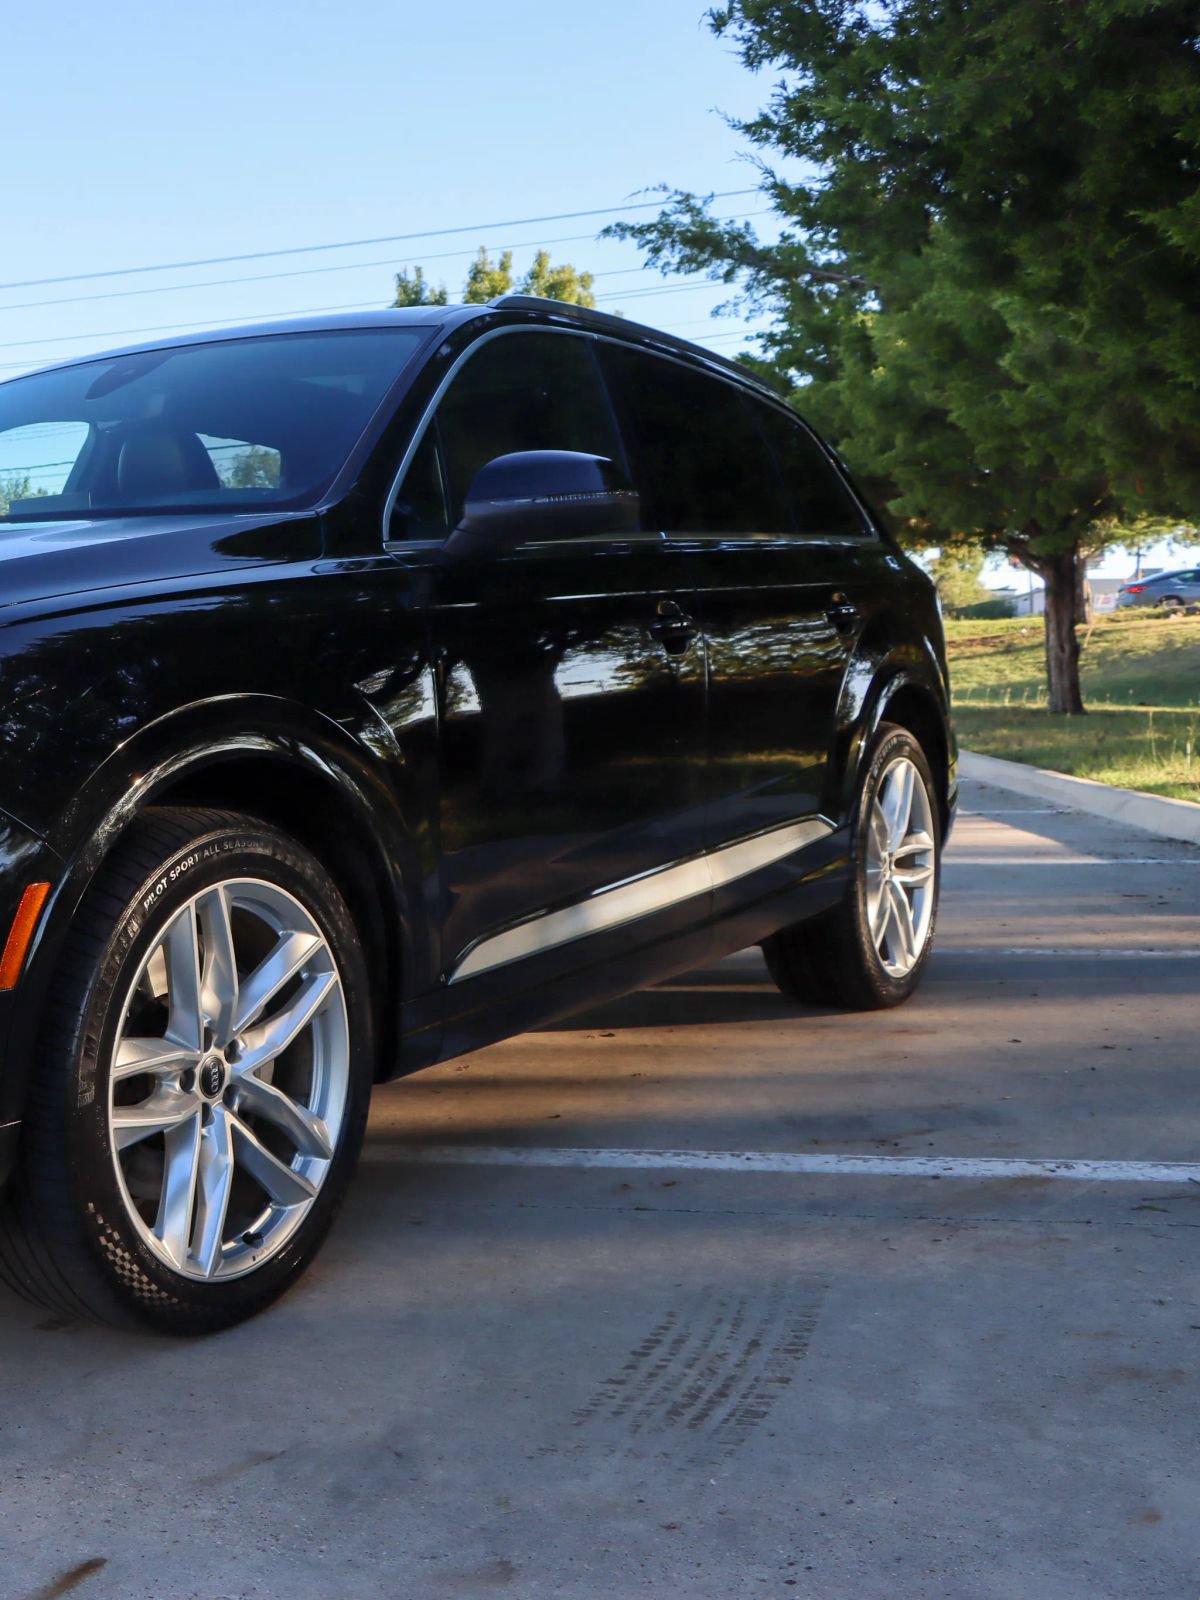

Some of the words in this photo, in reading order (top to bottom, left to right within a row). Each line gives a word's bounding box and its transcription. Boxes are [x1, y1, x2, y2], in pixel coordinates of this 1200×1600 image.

[143, 877, 168, 911] PILOT
[169, 853, 199, 881] SPORT
[203, 843, 220, 859] ALL
